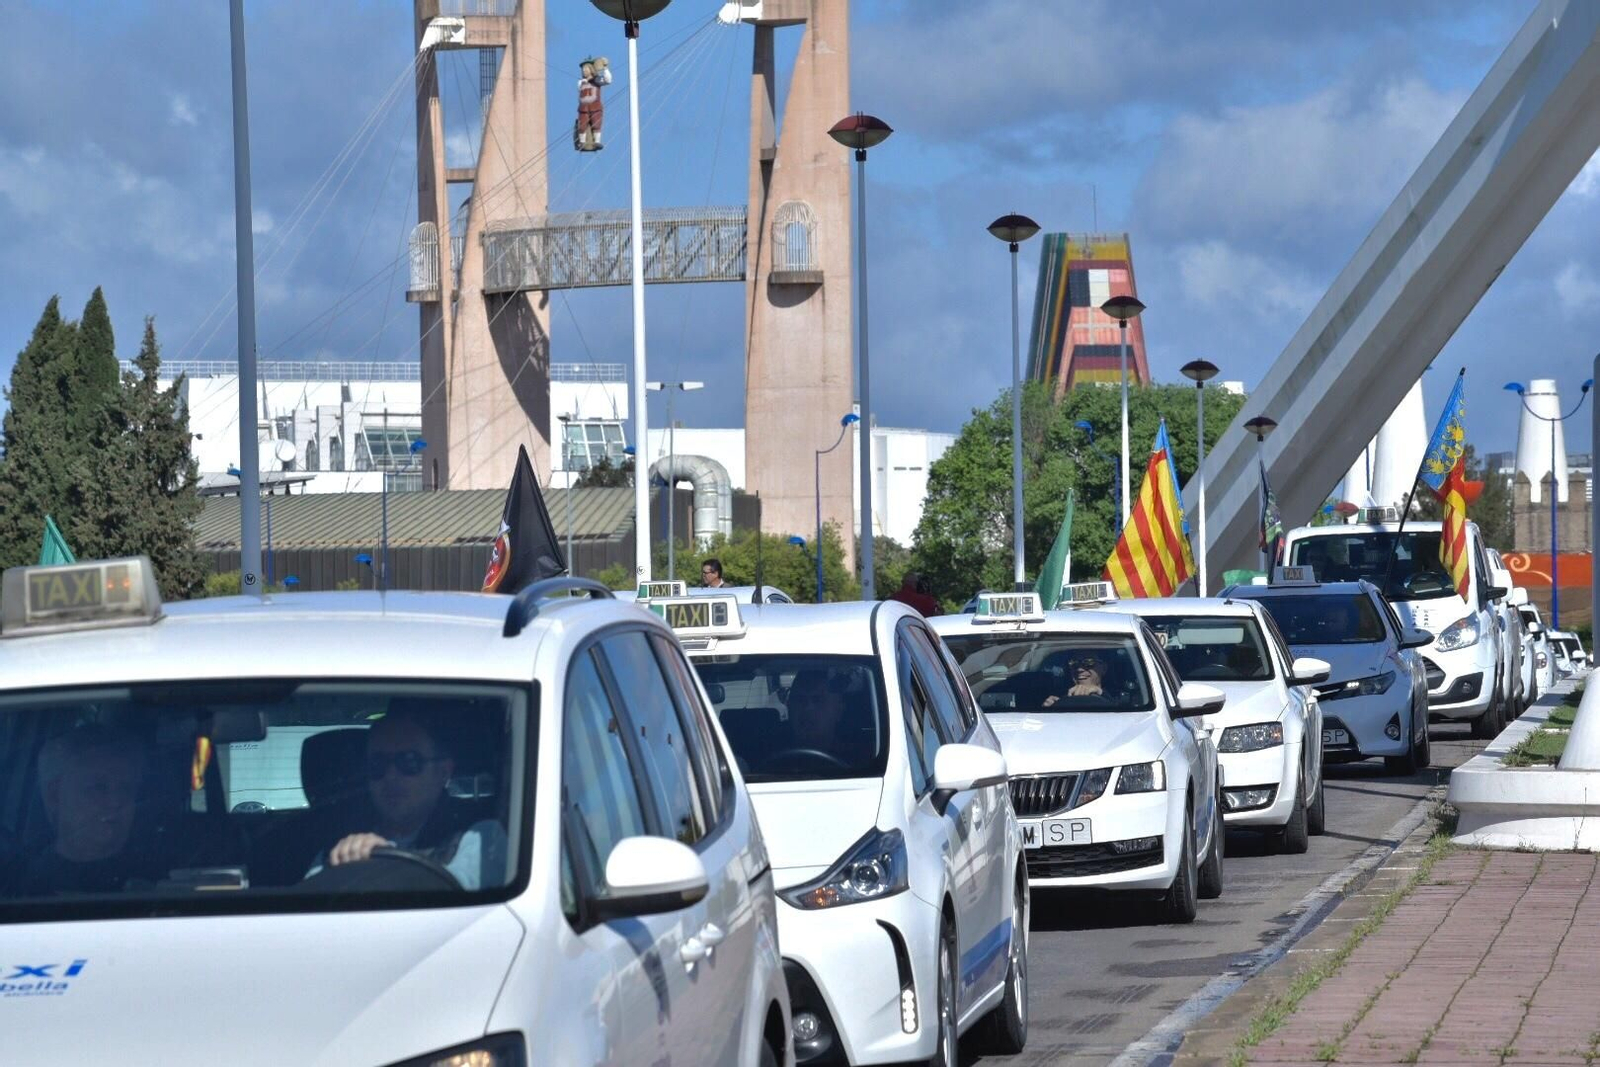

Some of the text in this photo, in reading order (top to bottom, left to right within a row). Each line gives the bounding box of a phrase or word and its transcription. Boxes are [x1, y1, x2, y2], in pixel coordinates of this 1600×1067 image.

[1283, 568, 1303, 580] TAXI
[31, 572, 100, 607] TAXI
[650, 584, 671, 597] TAXI
[1075, 584, 1096, 599] TAXI
[668, 603, 709, 627] TAXI
[993, 598, 1019, 615] TAXI
[1049, 822, 1085, 842] SP
[0, 959, 88, 979] xi
